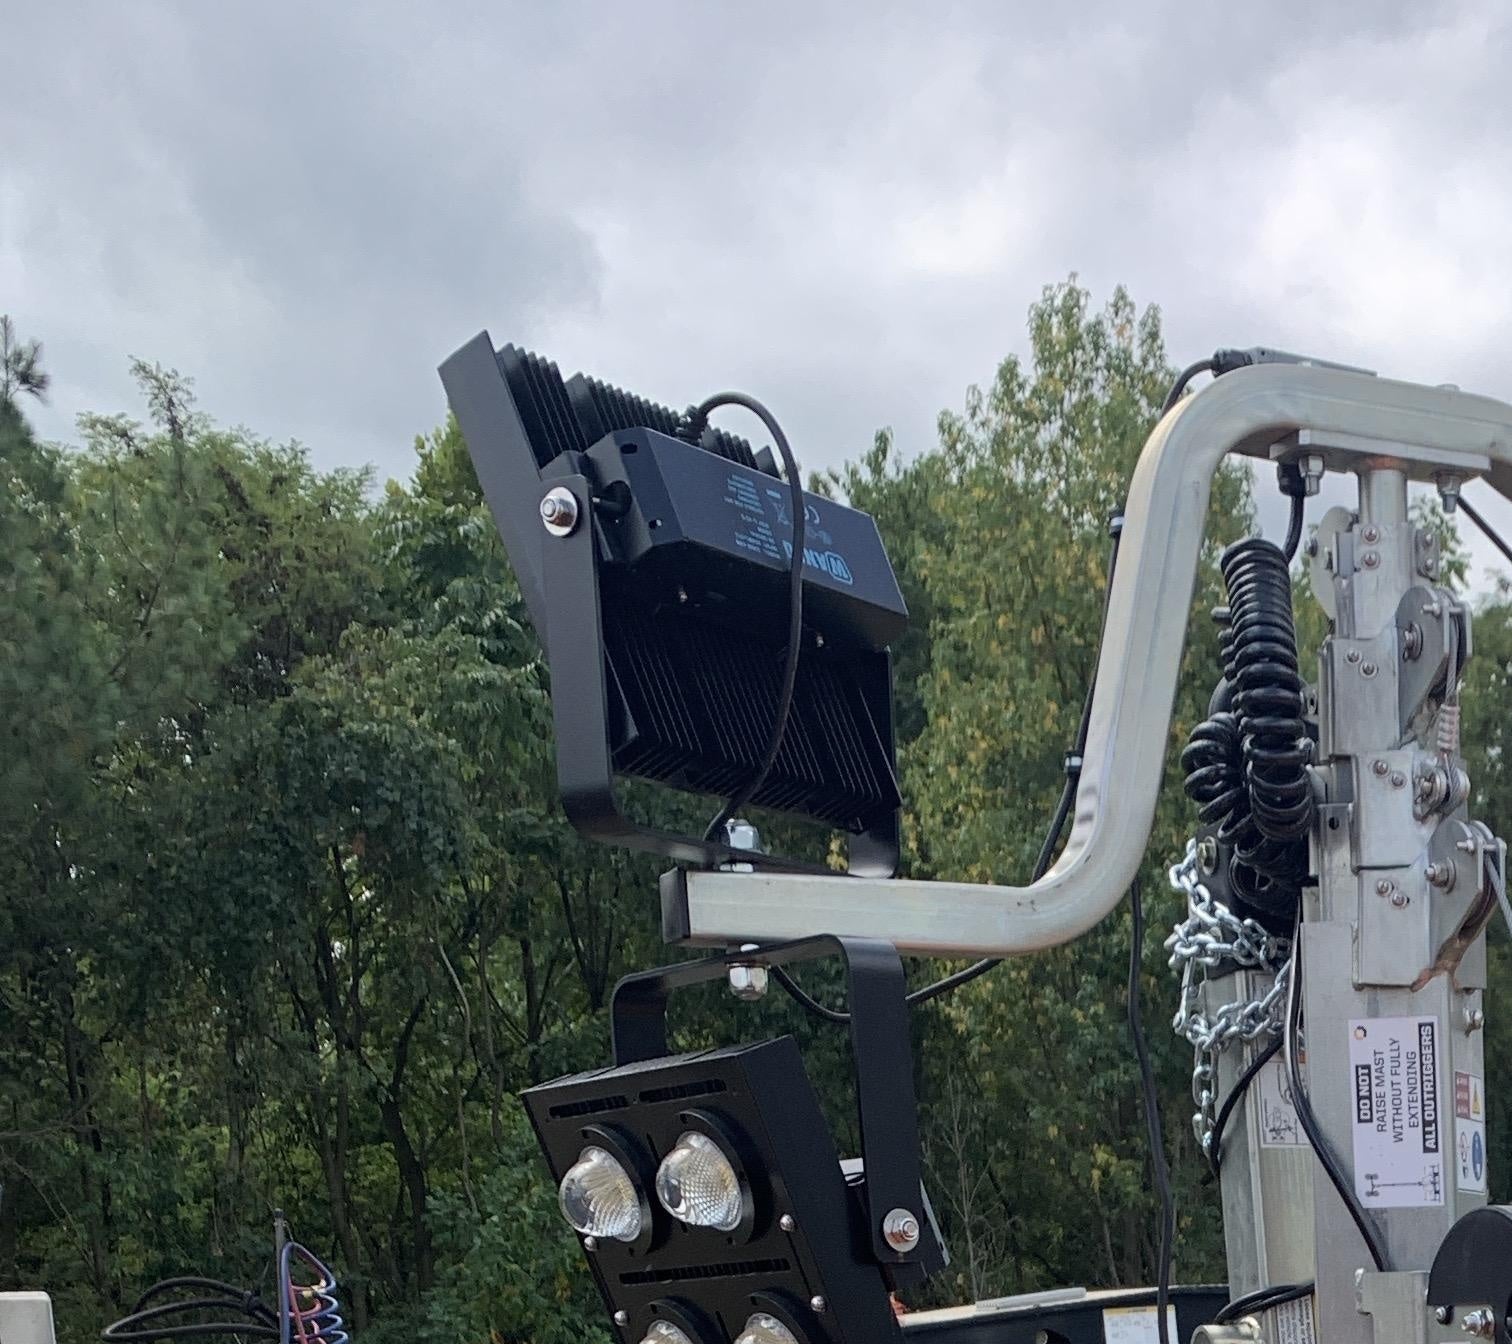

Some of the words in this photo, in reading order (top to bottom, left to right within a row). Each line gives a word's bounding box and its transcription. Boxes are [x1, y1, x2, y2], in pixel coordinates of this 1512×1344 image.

[782, 540, 853, 585] WANO
[1374, 1049, 1385, 1087] MAST
[1389, 1038, 1401, 1076] FULLY
[1421, 1025, 1436, 1120] OUTRIGGERS
[1358, 1067, 1370, 1097] NOT
[1406, 1051, 1419, 1128] EXTENDING
[1359, 1099, 1371, 1120] DO
[1376, 1092, 1387, 1133] RAISE
[1391, 1081, 1403, 1143] WITHOUT
[1424, 1123, 1437, 1149] ALL
